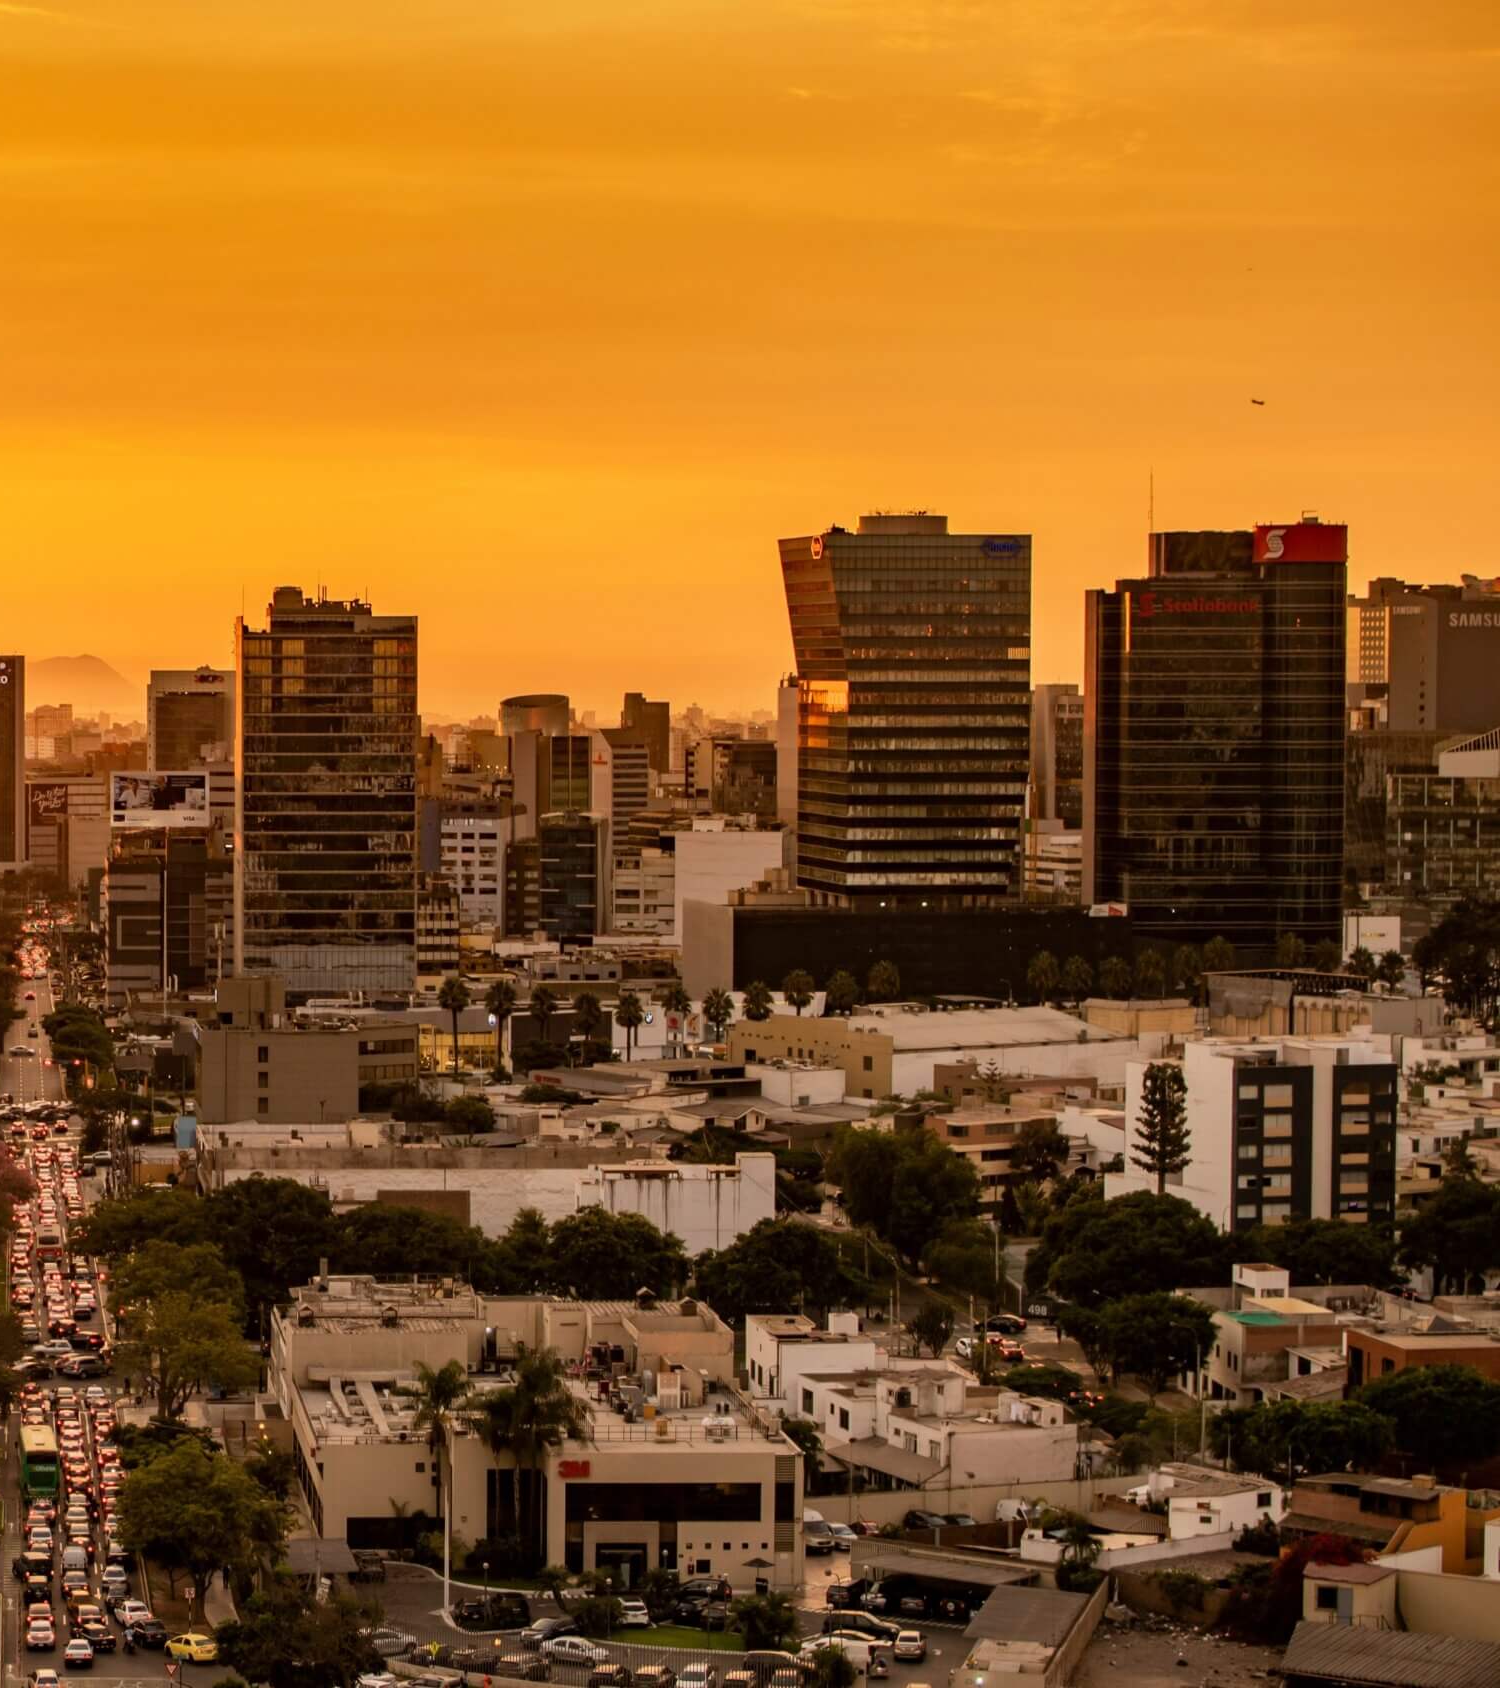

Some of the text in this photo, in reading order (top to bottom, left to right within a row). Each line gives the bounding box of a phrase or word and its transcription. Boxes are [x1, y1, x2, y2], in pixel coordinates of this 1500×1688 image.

[1163, 597, 1258, 613] Scotiabank
[1449, 613, 1500, 627] SAMSU
[558, 1460, 591, 1479] 3M
